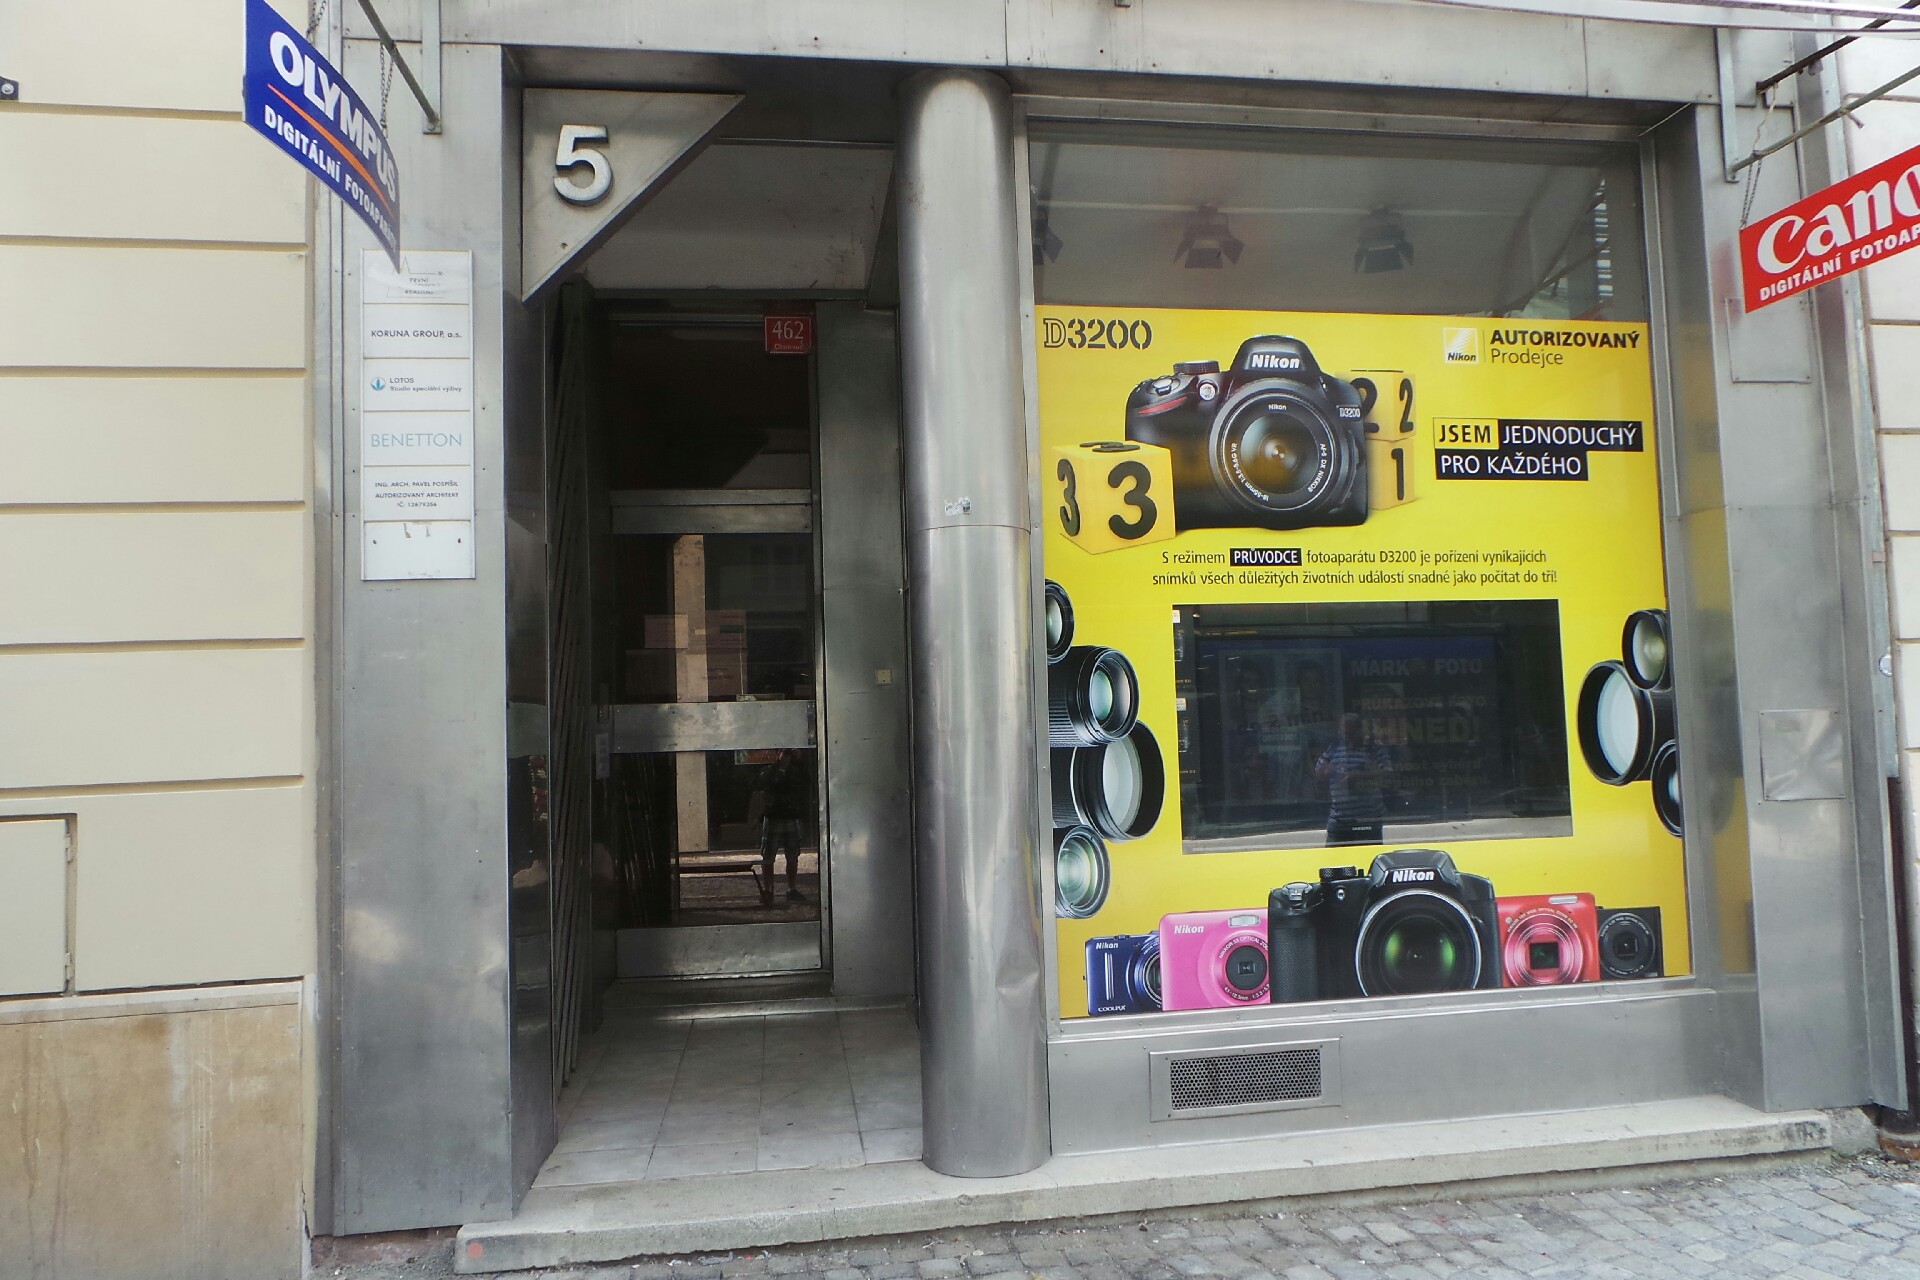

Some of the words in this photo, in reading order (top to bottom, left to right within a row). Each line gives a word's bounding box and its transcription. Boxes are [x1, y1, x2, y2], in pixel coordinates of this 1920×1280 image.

[270, 31, 395, 202] OLYMPUS
[264, 105, 341, 183] DIGITÁLNÍ
[553, 124, 612, 204] 5
[1760, 253, 1842, 301] DIGITÁLNÍ
[371, 330, 410, 338] KORUNA
[772, 320, 804, 340] 462
[1043, 317, 1153, 350] D3200
[1490, 329, 1640, 349] AUTORIZOVANÝ
[1251, 354, 1300, 369] Nikon
[1447, 352, 1477, 362] Nikon
[1491, 348, 1564, 368] Prodejce
[1268, 403, 1287, 411] Nikon
[1339, 407, 1361, 418] D3200
[1399, 377, 1414, 434] 2
[371, 433, 462, 447] BENETTON
[1439, 424, 1492, 443] JSEM
[1502, 422, 1637, 446] JEDNODUCHÝ
[1441, 455, 1481, 474] PRO
[1487, 451, 1582, 475] KAŽDÉHO
[1391, 447, 1404, 501] 1
[1057, 458, 1080, 537] 3
[1108, 460, 1158, 540] 3
[1162, 551, 1169, 564] S
[1173, 549, 1226, 564] režimem
[1233, 547, 1299, 564] PRŮVODCE
[1306, 549, 1376, 566] fotoaparátu
[1379, 550, 1417, 563] D3200
[1420, 550, 1431, 566] je
[1434, 549, 1479, 566] pořízení
[1482, 549, 1547, 566] vynikajících
[1152, 570, 1197, 585] snímků
[1200, 570, 1235, 585] všech
[1238, 569, 1299, 588] důležitých
[1302, 570, 1354, 584] životních
[1358, 569, 1405, 584] událostí
[1408, 569, 1450, 583] snadné
[1453, 570, 1477, 587] jako
[1480, 569, 1521, 586] počítat
[1523, 569, 1538, 583] do
[1392, 870, 1435, 884] Nikon
[1174, 925, 1204, 934] Nikon
[1095, 942, 1119, 950] Nikon
